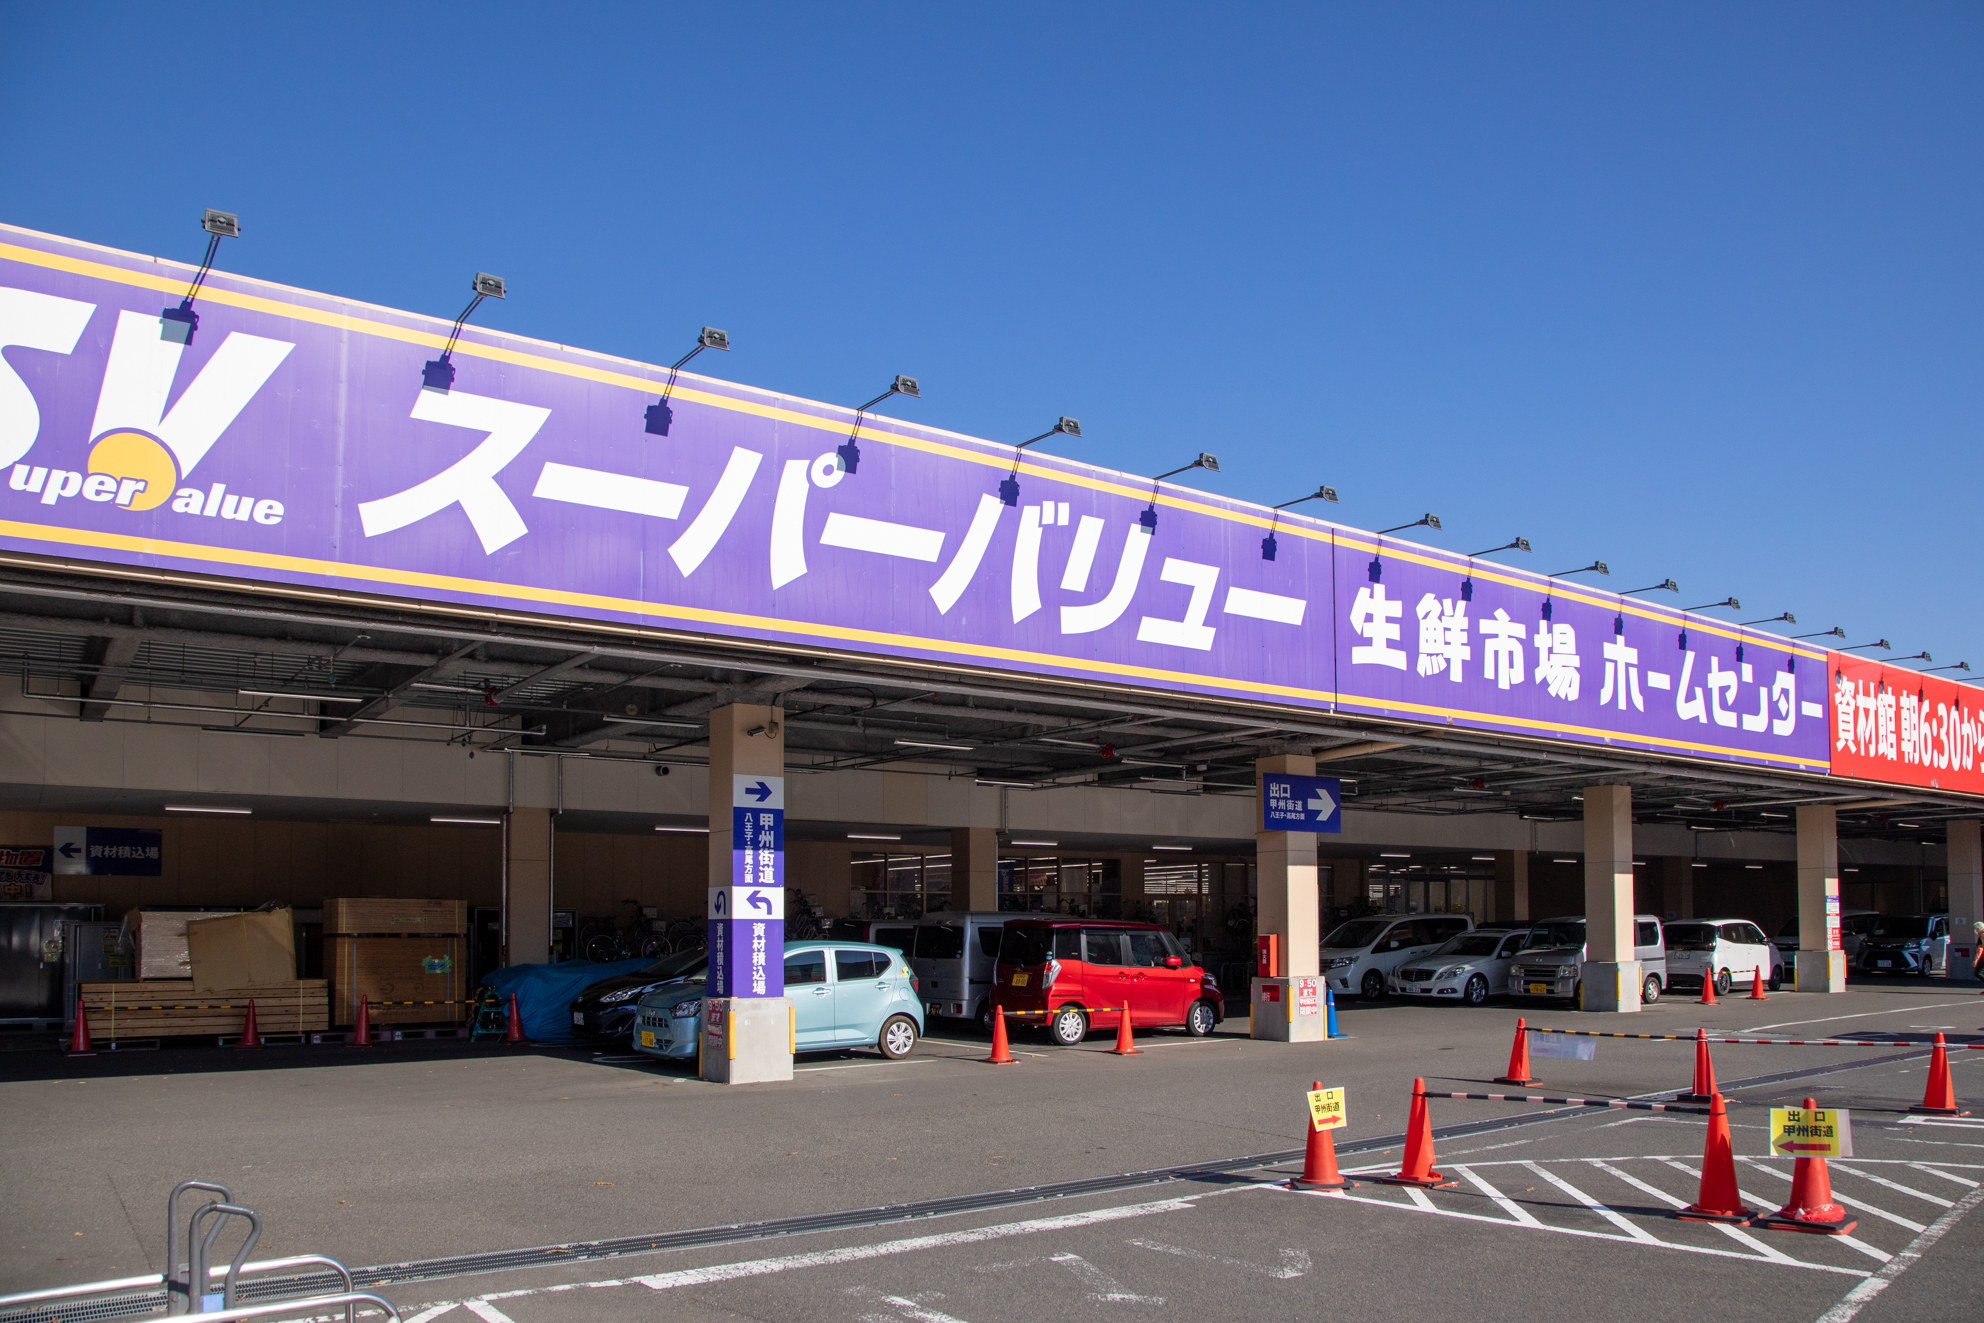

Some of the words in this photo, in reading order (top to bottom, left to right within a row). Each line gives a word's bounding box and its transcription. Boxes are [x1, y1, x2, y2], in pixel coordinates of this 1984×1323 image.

[9, 463, 146, 505] uper
[172, 483, 285, 525] alue
[358, 388, 1307, 651] スーパーバリュー
[1350, 583, 1580, 702] 生鮮市場
[1599, 635, 1823, 737] ホームセンター
[1834, 675, 1897, 761] 資材館
[1269, 782, 1291, 798] 出口
[1269, 798, 1303, 811] 甲州街道
[90, 844, 160, 860] 資材積込場
[758, 813, 775, 884] 甲州街道
[716, 922, 724, 995] 資材積込場
[752, 922, 766, 995] 資材積込場
[1299, 979, 1317, 988] 9:50
[1302, 988, 1313, 996] まで
[707, 1000, 723, 1011] 9:50
[711, 1012, 720, 1022] まで
[1314, 1091, 1334, 1102] 出口
[1314, 1101, 1341, 1114] 甲州街道
[1787, 1111, 1826, 1122] 出口
[1783, 1125, 1834, 1138] 甲州街道
